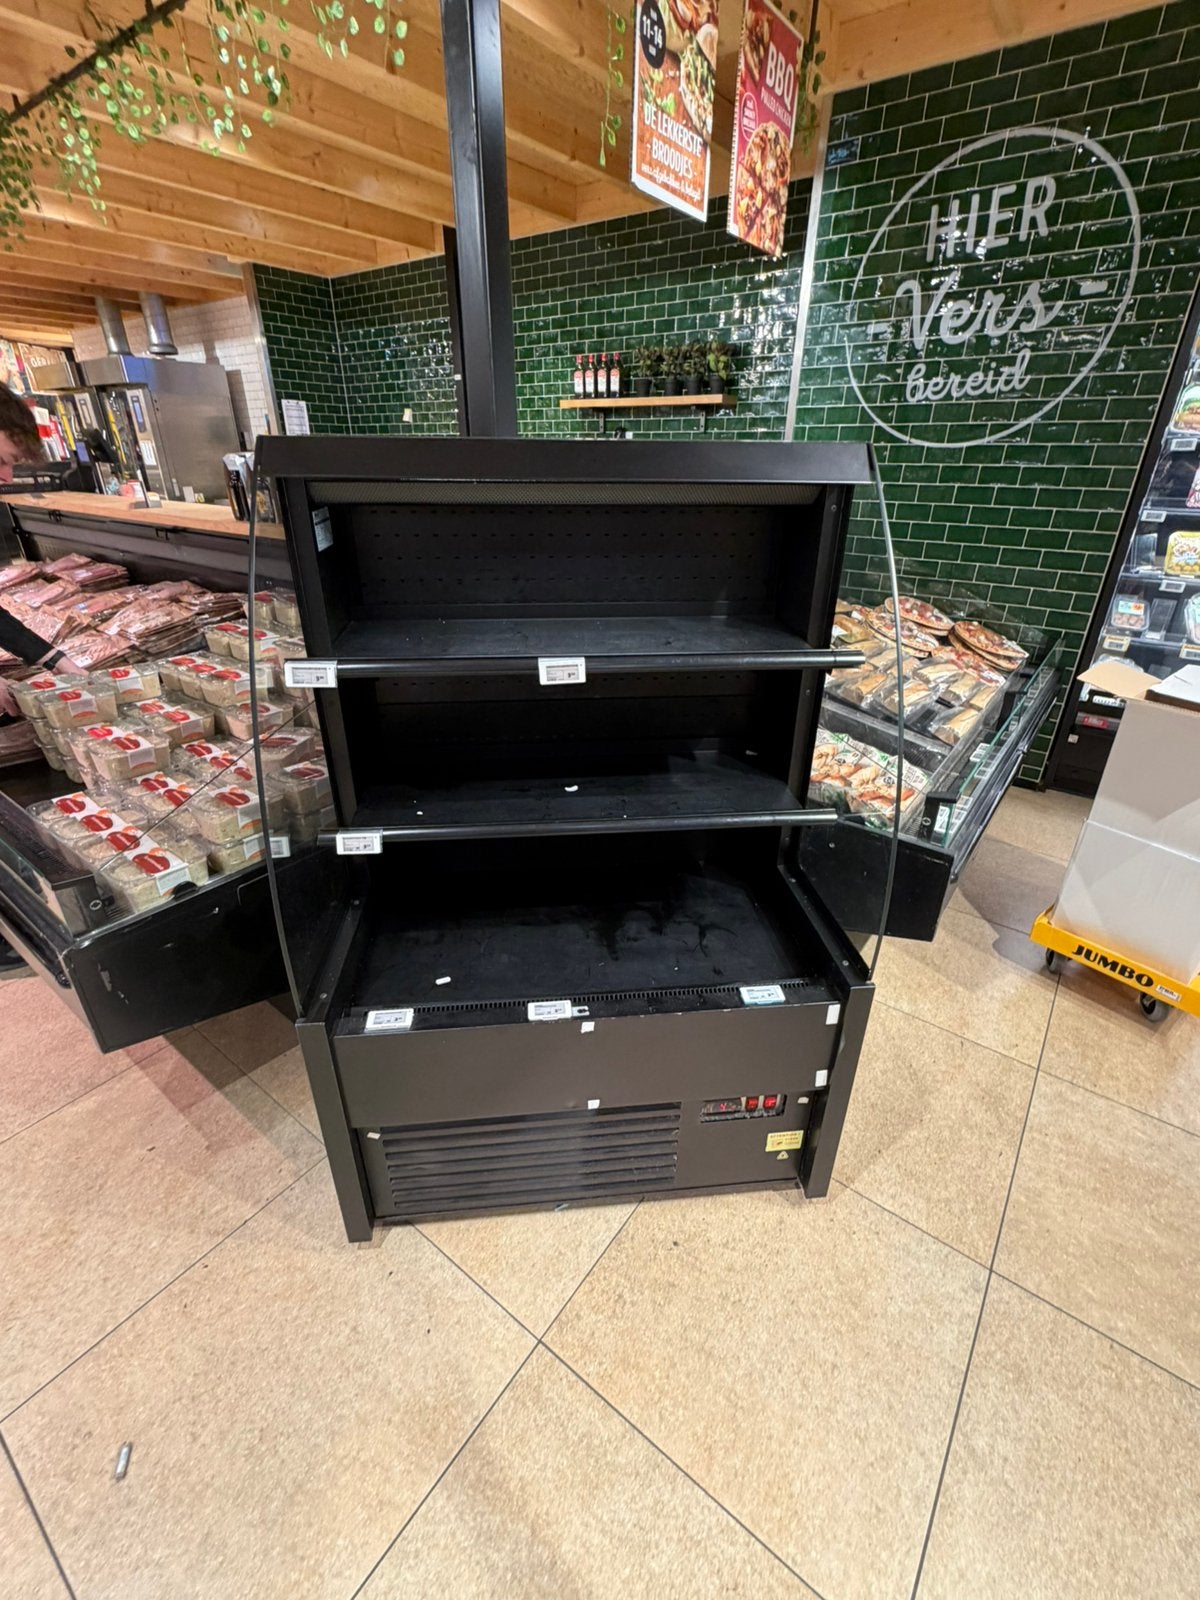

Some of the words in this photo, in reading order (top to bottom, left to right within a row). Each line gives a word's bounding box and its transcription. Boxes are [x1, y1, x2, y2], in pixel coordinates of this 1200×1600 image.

[642, 14, 663, 49] 11-14
[766, 41, 794, 112] BBQ
[643, 102, 657, 130] DE
[658, 110, 704, 158] LEKKERSTE
[652, 137, 693, 179] BROODJES
[926, 175, 1057, 263] HIER
[895, 270, 1063, 351] Vers
[905, 348, 1032, 403] bereid
[1072, 944, 1154, 987] JUMBO
